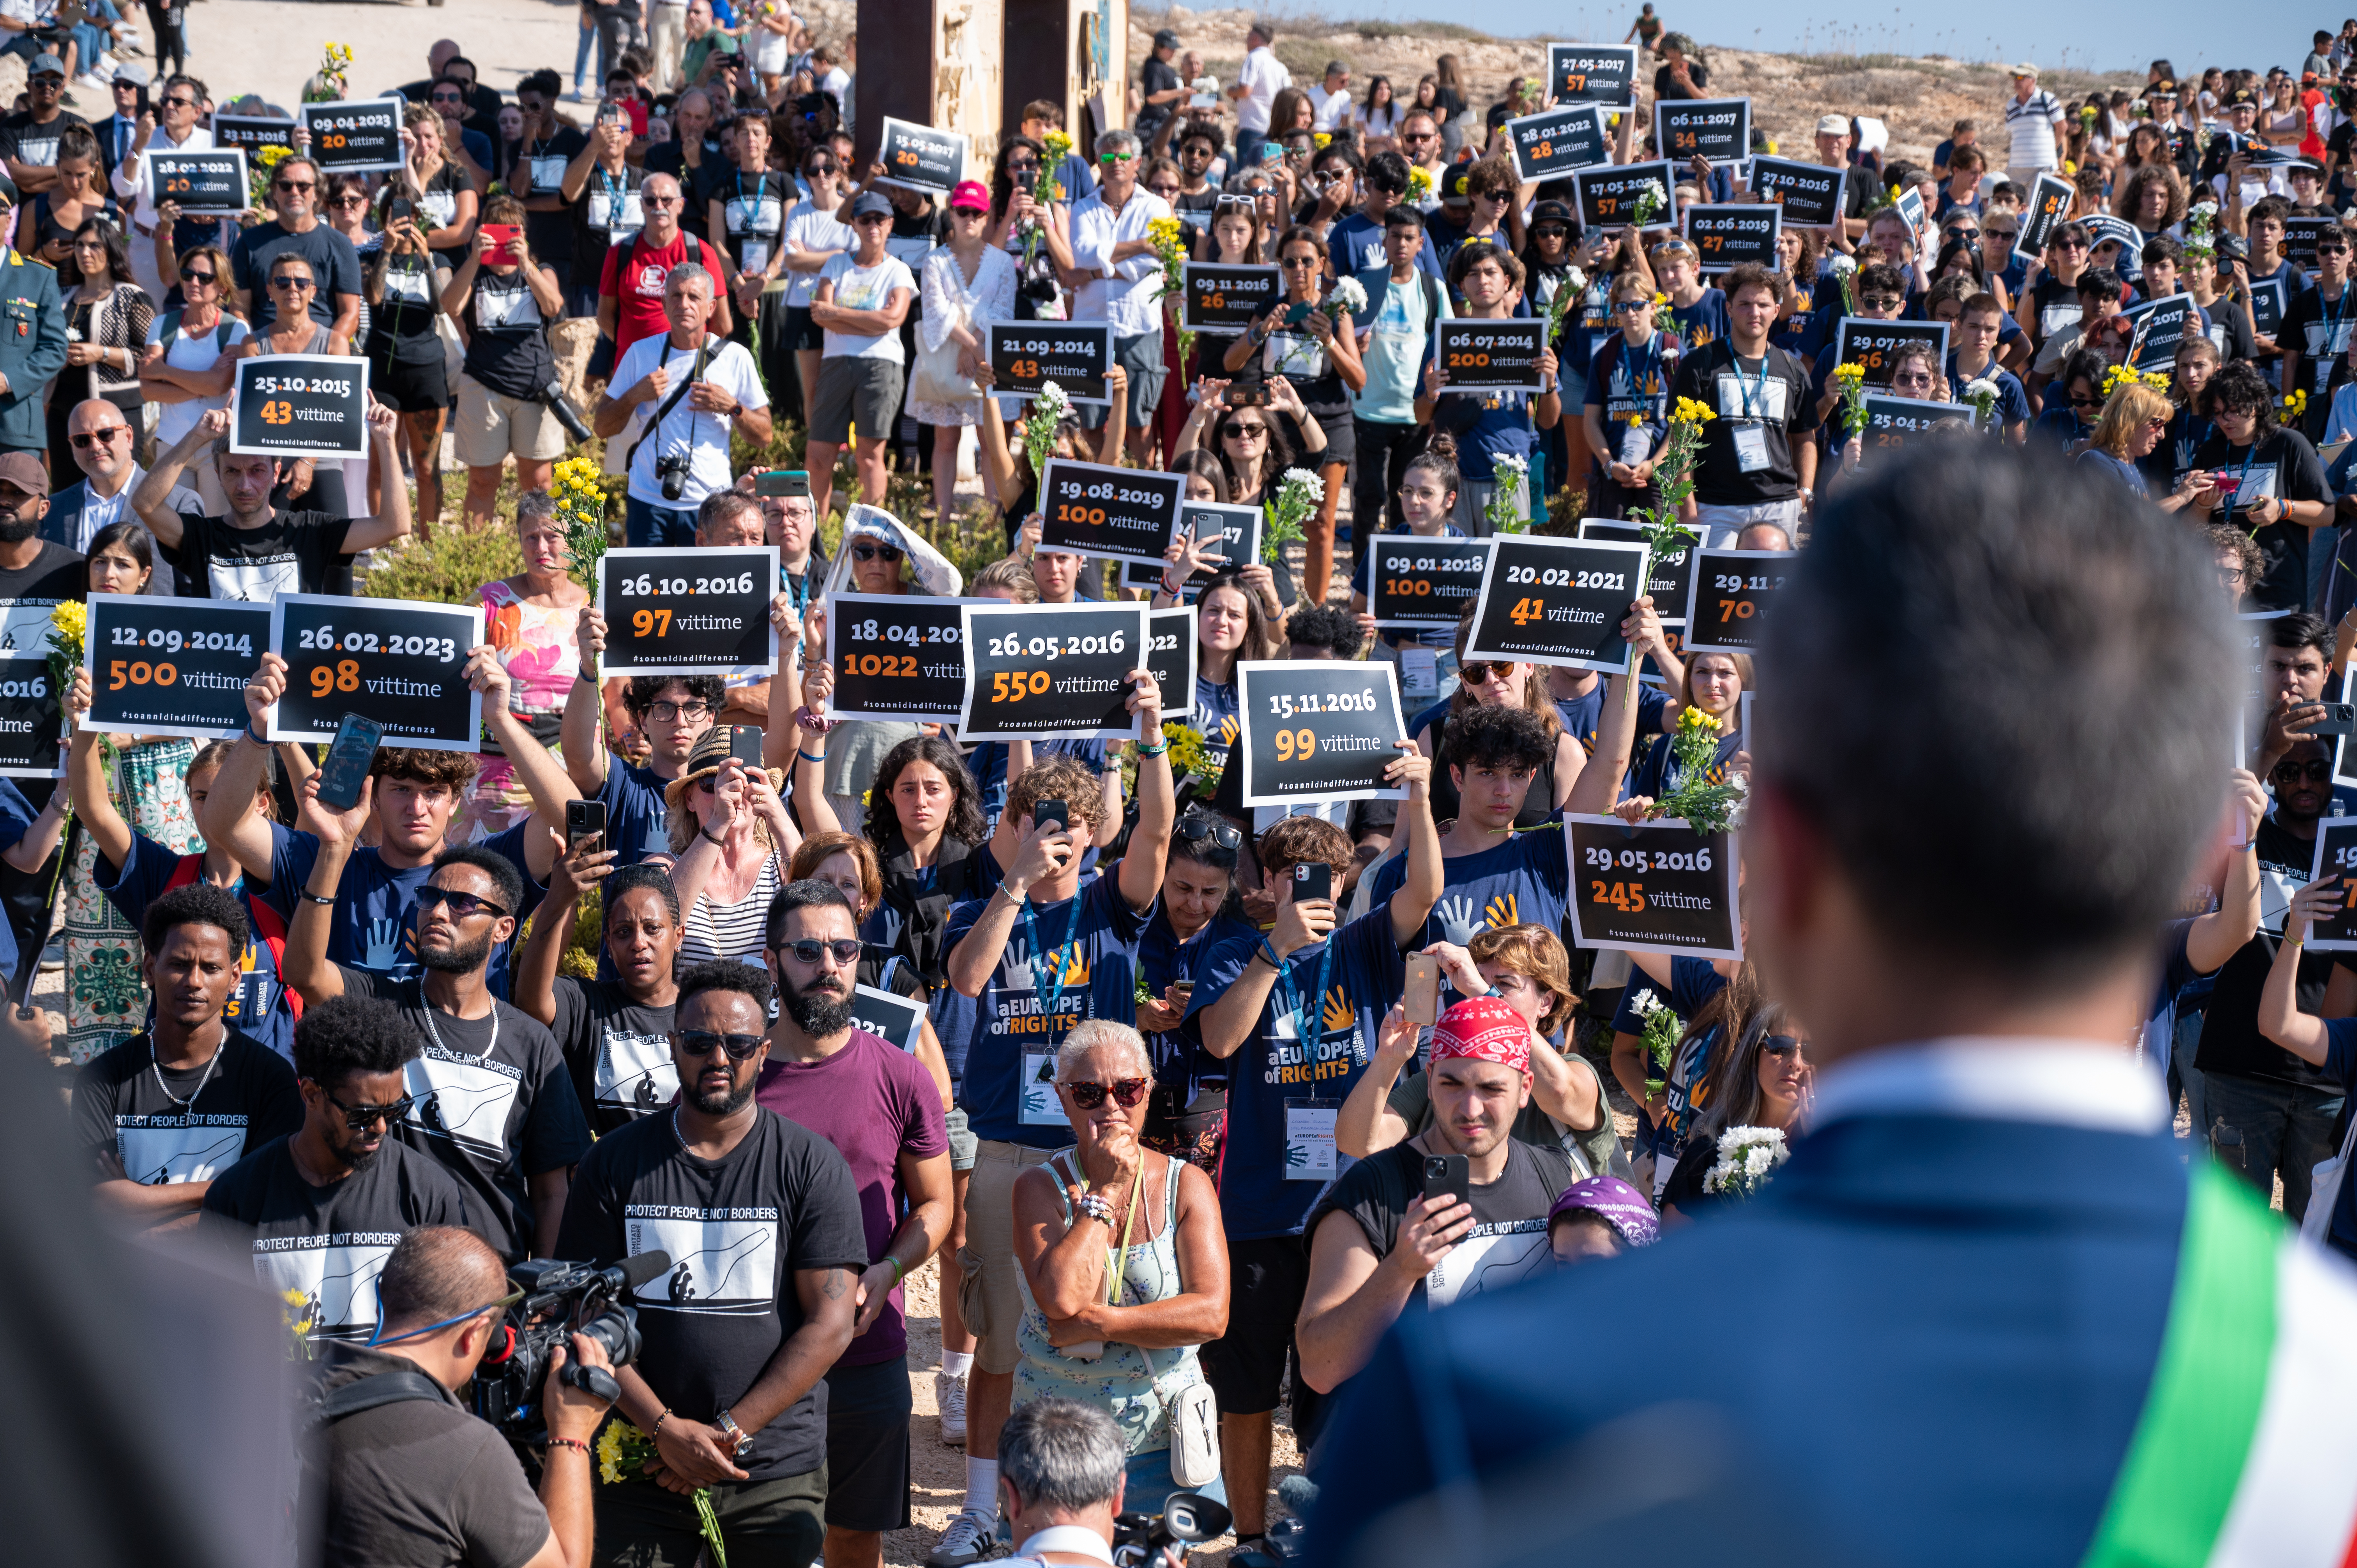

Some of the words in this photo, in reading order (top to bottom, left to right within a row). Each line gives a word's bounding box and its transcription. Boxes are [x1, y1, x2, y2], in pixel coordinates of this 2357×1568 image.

[1562, 58, 1625, 73] 27.05.2017
[1567, 74, 1585, 92] 57
[1587, 78, 1619, 89] vittime
[313, 114, 391, 129] 09.04.2023
[1671, 113, 1737, 127] 06.11.2017
[224, 129, 288, 143] 23.12.2016
[1521, 119, 1591, 145] 28.01.2022
[1676, 130, 1697, 148] 34
[1699, 132, 1732, 144] vittime
[323, 135, 346, 148] 20
[348, 135, 385, 147] vittime
[896, 134, 955, 157] 15.05.2017
[1530, 142, 1553, 160] 28
[1554, 140, 1590, 155] vittime
[158, 162, 234, 174] 28.02.2022
[896, 151, 918, 166] 20
[919, 159, 951, 173] vittime
[167, 178, 190, 192] 20
[193, 180, 229, 192] vittime
[1762, 171, 1830, 192] 27.10.2016
[1598, 197, 1617, 215] 57
[1788, 196, 1822, 210] vittime
[1696, 219, 1770, 231] 02.06.2019
[1703, 236, 1724, 253] 27
[1725, 239, 1760, 250] vittime
[1196, 279, 1270, 291] 09.11.2016
[1201, 293, 1224, 309] 26
[1226, 300, 1258, 310] vittim
[1003, 339, 1096, 355] 21.09.2014
[1449, 335, 1534, 349] 06.07.2014
[2147, 332, 2183, 347] vittime
[1449, 353, 1490, 367] 200
[1492, 355, 1532, 366] vittime
[1857, 351, 1882, 367] 26
[1011, 360, 1038, 378] 43
[1041, 364, 1088, 377] vittime
[255, 376, 351, 398] 25.10.2015
[261, 400, 292, 425] 43
[295, 408, 344, 422] vittime
[261, 437, 340, 448] #10annidindifferenza
[1060, 480, 1164, 509] 19.08.2019
[1057, 504, 1105, 525] 100
[1109, 516, 1159, 532] vittime
[1064, 539, 1145, 554] #10annidindifferenza
[209, 554, 234, 567] PROTECT
[235, 555, 254, 565] PEOPLE
[255, 554, 268, 564] NOT
[269, 552, 296, 563] BORDERS
[1386, 555, 1483, 574] 09.01.2018
[622, 572, 753, 595] 26.10.2016
[1507, 566, 1625, 591] 20.02.2021
[1386, 579, 1430, 596] 100
[1434, 585, 1481, 597] vittime
[1510, 598, 1544, 625] 41
[1547, 609, 1604, 624] vittime
[1719, 600, 1754, 622] 70
[633, 609, 672, 637] 97
[677, 615, 741, 630] vittime
[112, 627, 252, 657] 12.09.2014
[299, 625, 455, 662] 26.02.2023
[989, 630, 1125, 660] 26.05.2016
[1500, 642, 1595, 656] #10annidindifferenza
[845, 654, 918, 677] 1022
[109, 660, 177, 691] 500
[183, 670, 251, 691] vittime
[310, 659, 359, 697] 98
[366, 677, 441, 697] vittime
[991, 671, 1050, 702] 550
[1055, 677, 1119, 694] vittime
[1270, 688, 1376, 719] 15.11.2016
[122, 711, 235, 725] #10annidindifferenza
[998, 717, 1101, 728] #10annidindifferenza
[1275, 728, 1316, 761] 99
[1320, 734, 1380, 752] vittime
[1279, 778, 1373, 790] #10annidindifferenza
[1586, 848, 1712, 874] 29.05.2016
[1592, 880, 1645, 912] 245
[1649, 891, 1711, 910] vittime
[1609, 929, 1706, 943] #10annidindifferenza
[256, 982, 265, 1016] COMITATO
[998, 995, 1082, 1016] aEUROPE
[991, 1014, 1078, 1035] ofRIGHTS
[602, 1025, 633, 1042] PROTECT
[634, 1030, 664, 1044] PEOPLE
[484, 1058, 523, 1080] BORDERS
[1265, 1058, 1349, 1084] ofRIGHTS
[151, 1115, 186, 1127] PEOPLE
[207, 1114, 249, 1126] BORDERS
[625, 1204, 669, 1217] PROTECT
[670, 1206, 708, 1220] PEOPLE
[710, 1207, 729, 1220] NOT
[731, 1206, 778, 1220] BORDERS
[1494, 1221, 1512, 1236] NOT
[252, 1236, 296, 1252] PROTECT
[297, 1234, 330, 1248] PEOPLE
[332, 1233, 351, 1245] NOT
[353, 1232, 401, 1245] BORDERS
